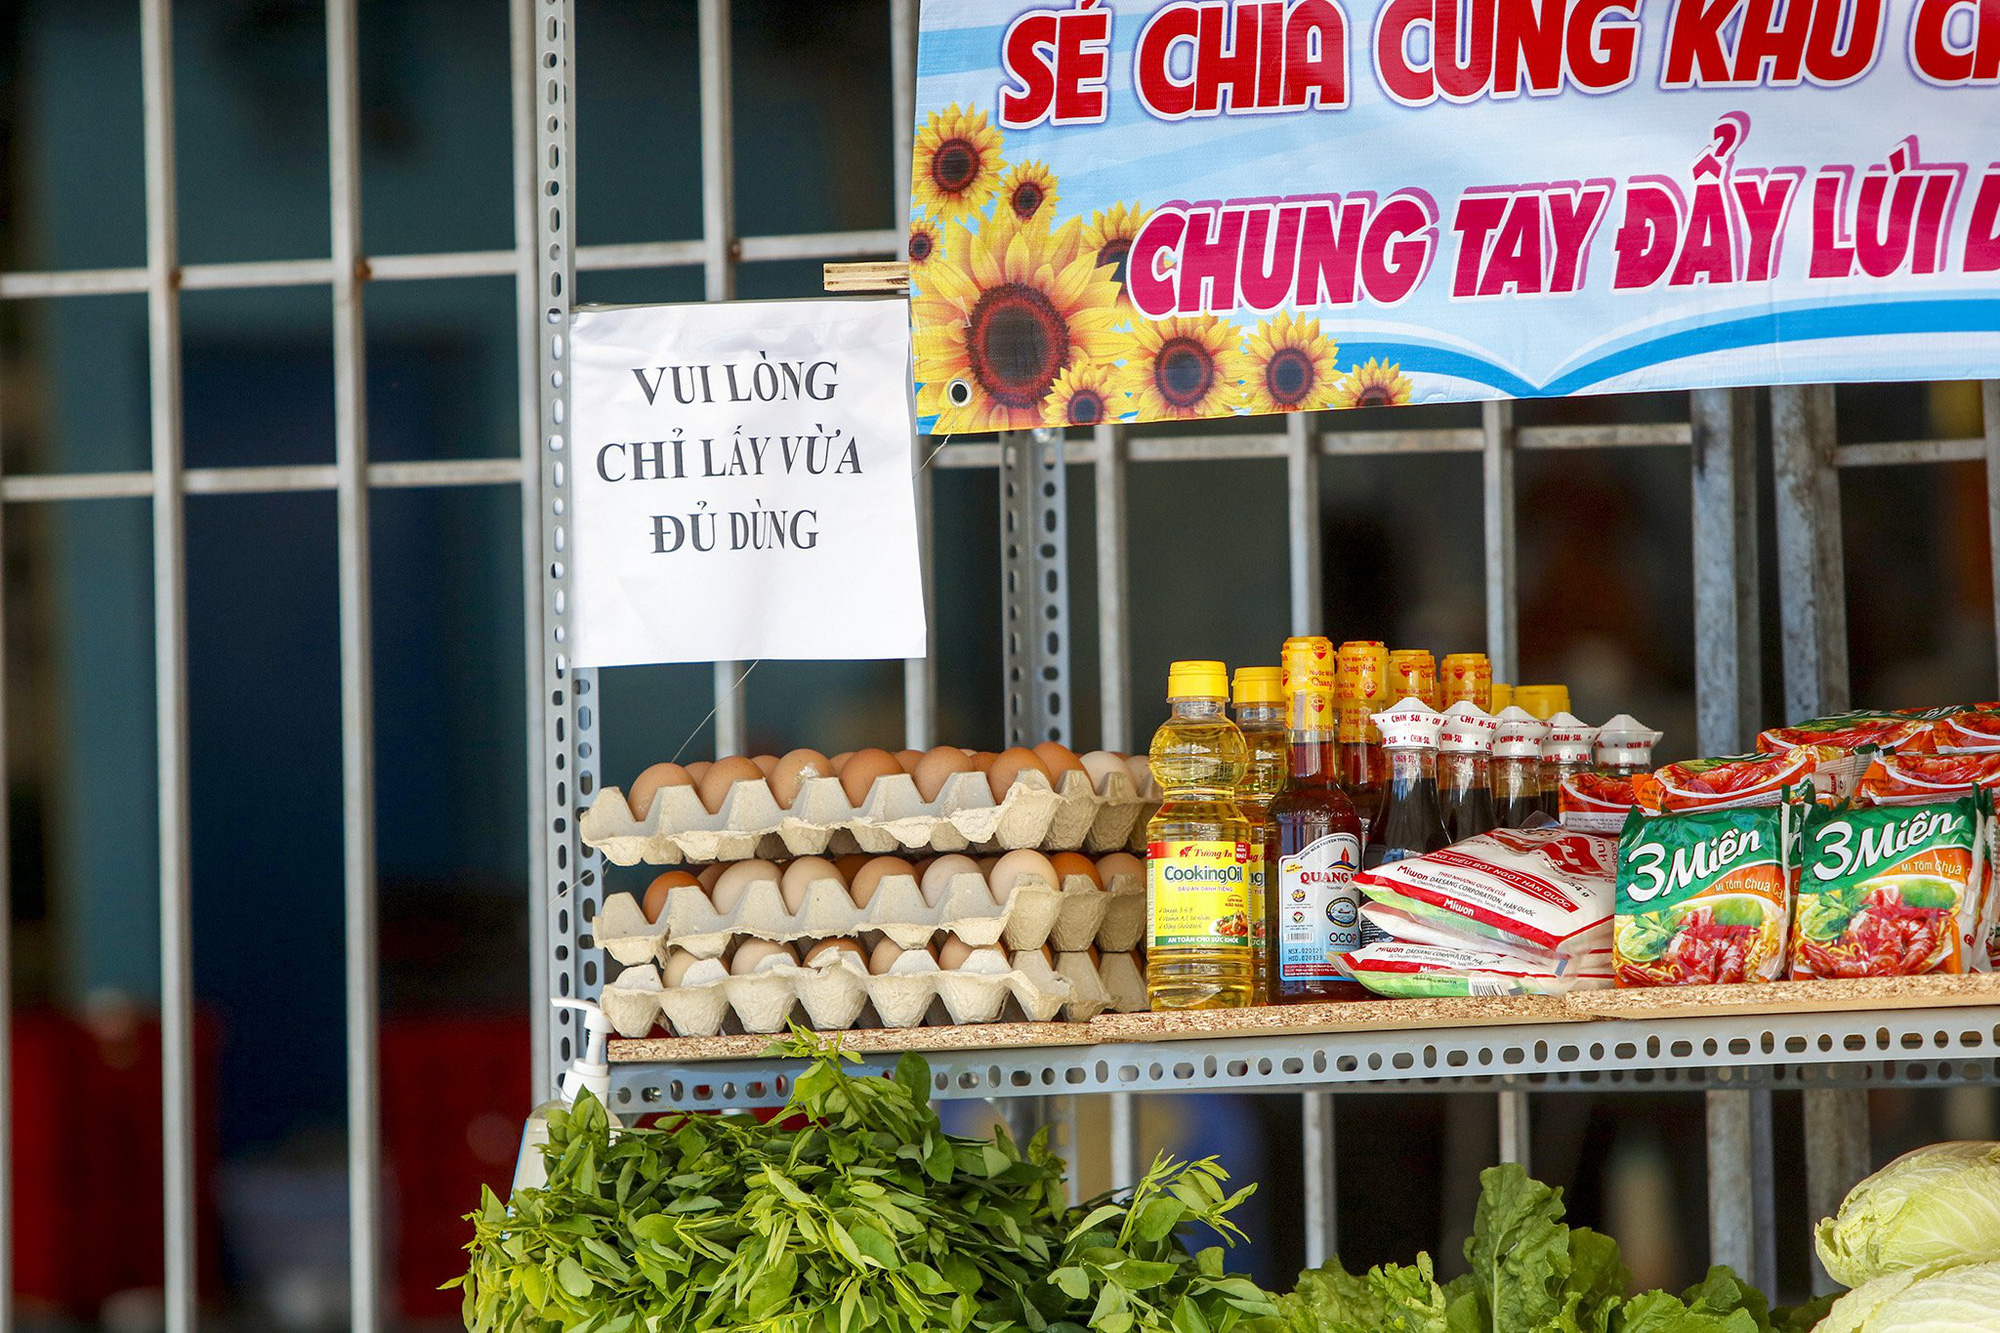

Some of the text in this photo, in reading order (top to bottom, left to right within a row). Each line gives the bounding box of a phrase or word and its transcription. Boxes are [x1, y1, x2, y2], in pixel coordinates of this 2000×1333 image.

[1137, 0, 1347, 116] CHIA
[1663, 0, 1883, 85] KHU
[1912, 0, 2000, 85] C
[1128, 192, 1437, 318] CHUNG
[1451, 182, 1612, 299] TAY
[1612, 115, 1800, 291] ĐẨY
[1806, 141, 1963, 279] LÙI
[631, 351, 839, 406] VUI LÒNG
[596, 423, 863, 482] CHỈ LẤY VỪA
[649, 499, 819, 554] ĐỦ DÙNG
[1626, 843, 1666, 902] 3
[1661, 828, 1762, 897] Miền
[1812, 821, 1853, 882] 3
[1847, 810, 1964, 876] Miền
[1914, 860, 1932, 871] Tôm
[1934, 860, 1962, 875] Chua
[1300, 872, 1349, 885] QUANG
[1396, 865, 1429, 881] Miwon
[1429, 876, 1459, 888] DAESANG
[1725, 880, 1742, 890] Tôm
[1744, 878, 1770, 892] Chua
[1443, 898, 1475, 916] Miwon
[1329, 932, 1358, 943] OCOP
